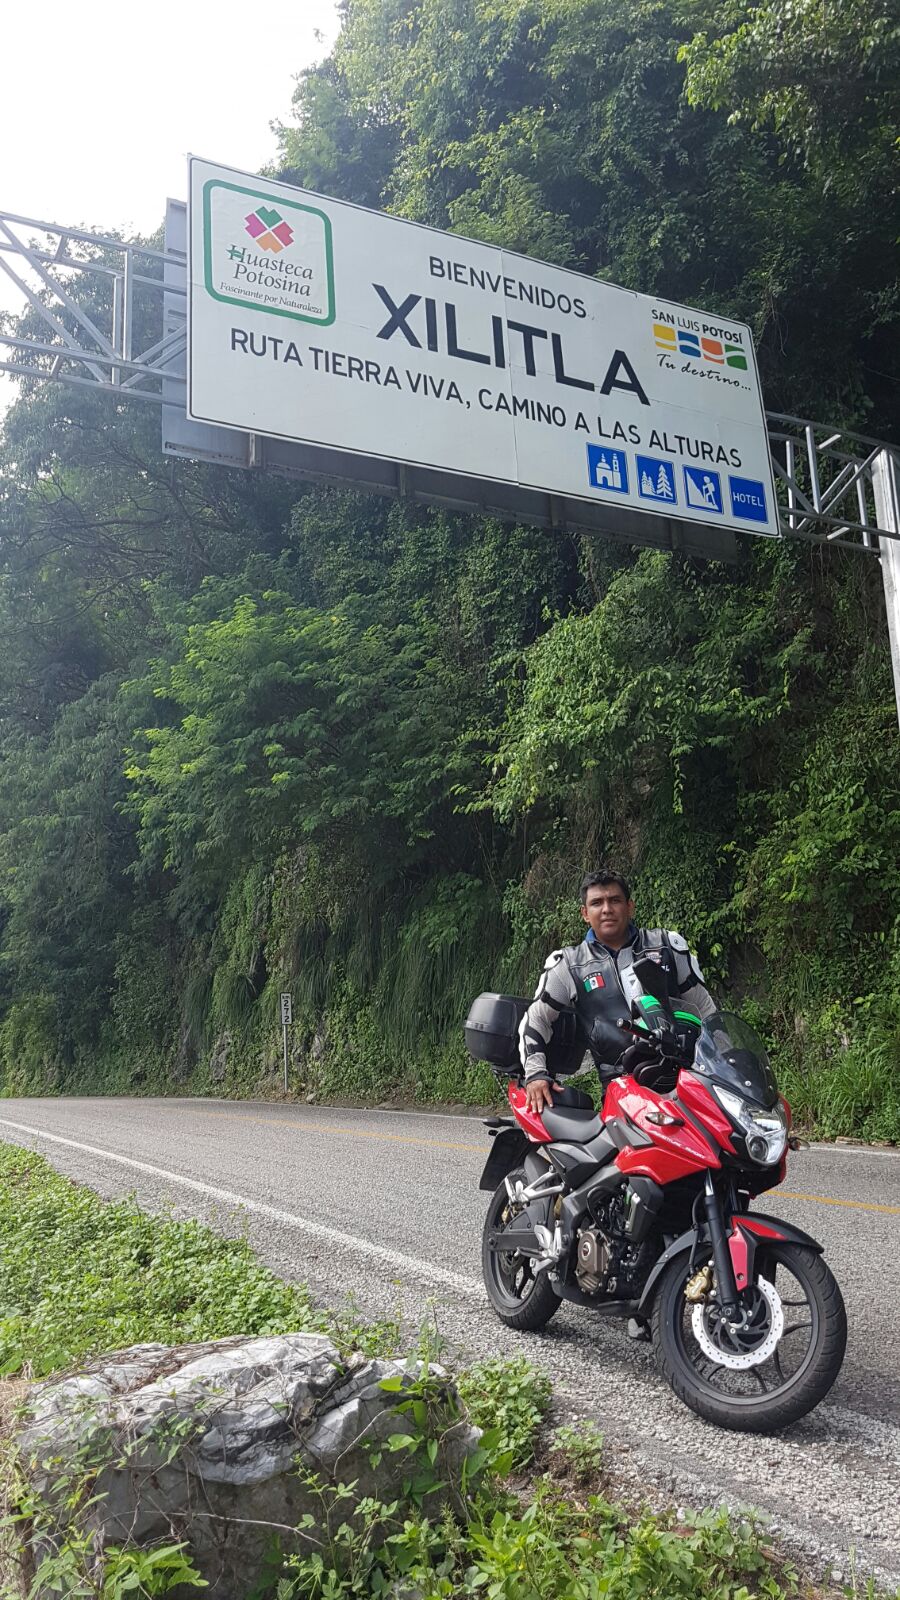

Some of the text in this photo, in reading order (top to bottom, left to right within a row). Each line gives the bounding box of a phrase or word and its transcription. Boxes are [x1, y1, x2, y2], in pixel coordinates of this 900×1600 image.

[226, 244, 313, 280] Huasteca
[232, 263, 311, 296] Potosina
[220, 282, 322, 314] Fascinante por Naturaleza
[429, 256, 587, 318] BIENVENIDOS
[372, 283, 651, 406] XILITLA
[651, 309, 742, 344] SAN LUIS POTOSÍ
[656, 353, 751, 391] Tu destino...
[231, 328, 742, 468] RUTA TIERRA VIVA, CAMINO A LAS ALTURAS
[733, 491, 764, 508] HOTEL
